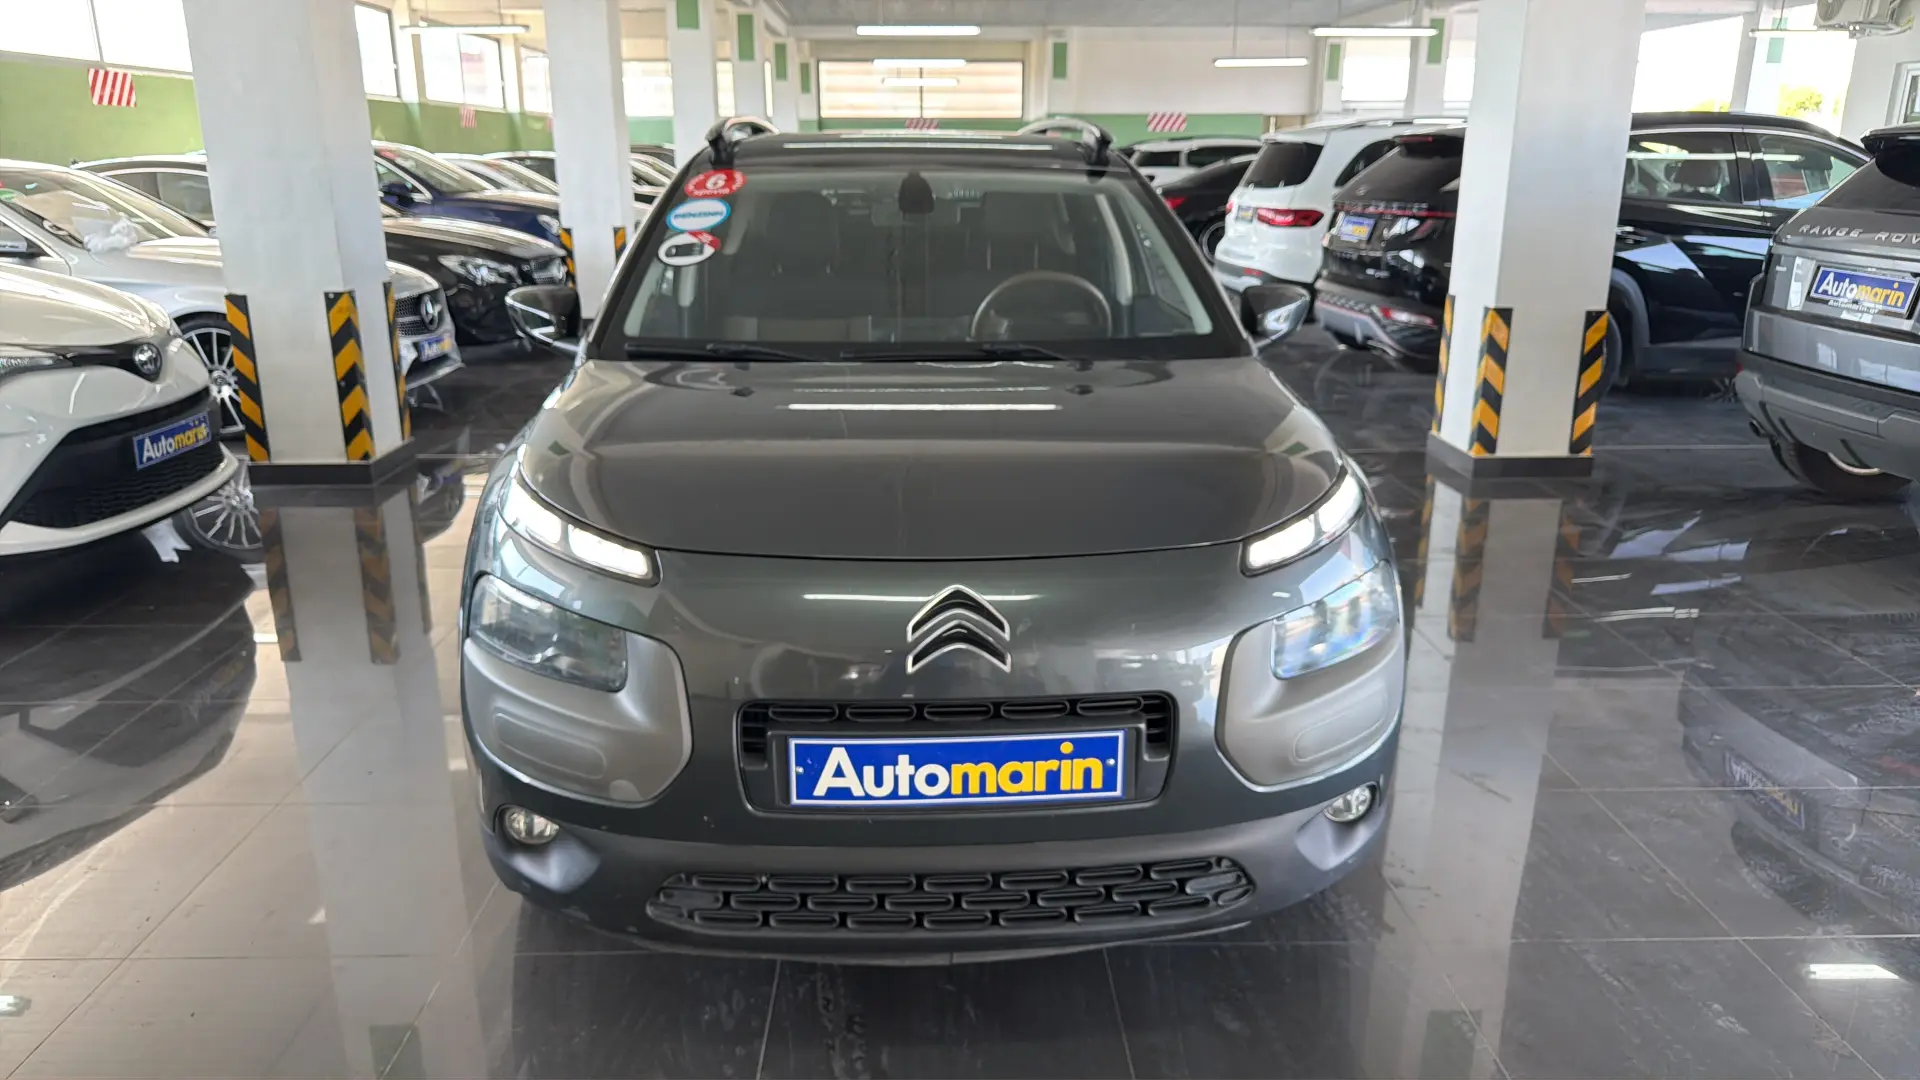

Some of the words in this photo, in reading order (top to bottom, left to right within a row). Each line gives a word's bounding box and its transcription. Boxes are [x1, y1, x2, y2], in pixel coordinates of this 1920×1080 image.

[1799, 224, 1864, 238] RANGE
[1818, 271, 1905, 307] Automarin
[813, 741, 1103, 797] Automarin
